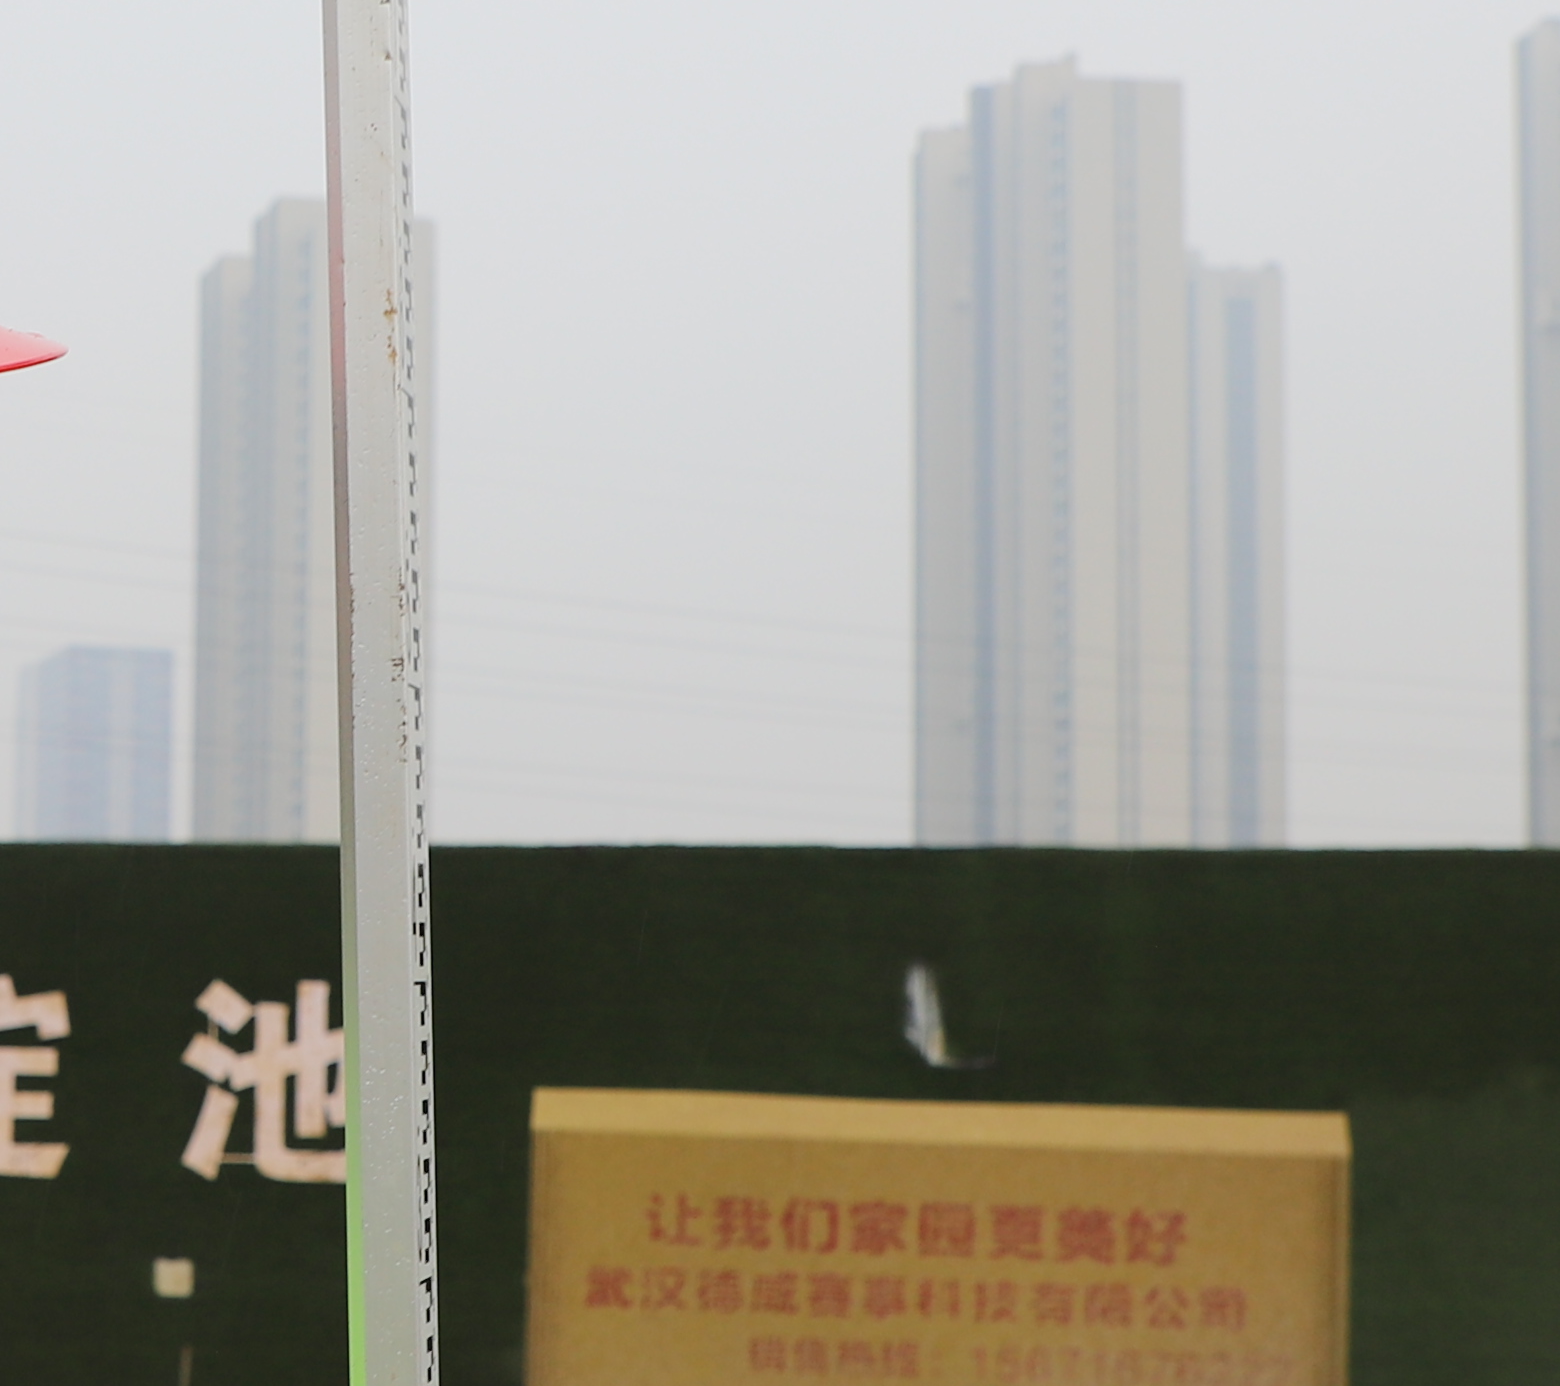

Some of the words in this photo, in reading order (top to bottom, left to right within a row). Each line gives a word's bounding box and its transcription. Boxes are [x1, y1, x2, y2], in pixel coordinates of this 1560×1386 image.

[645, 1191, 1187, 1268] 让我们家园更美好
